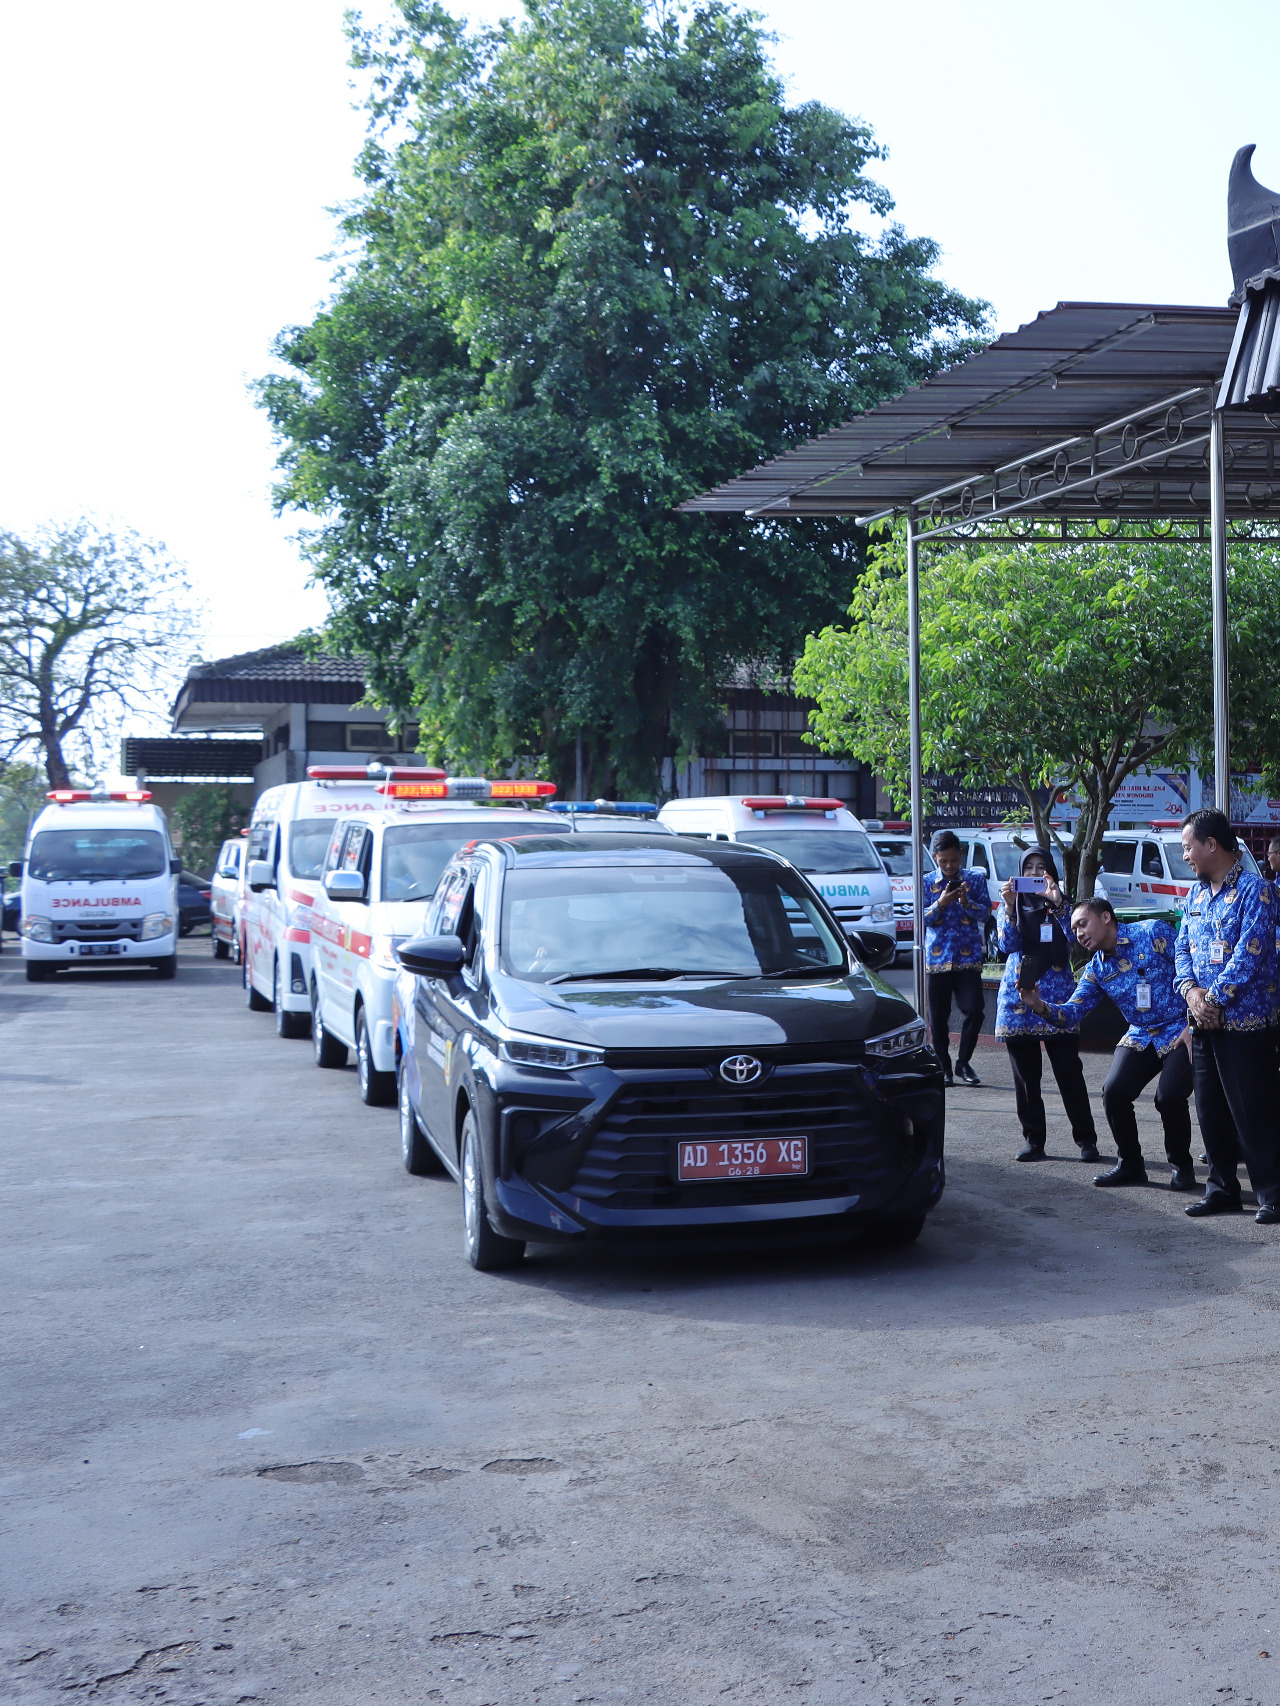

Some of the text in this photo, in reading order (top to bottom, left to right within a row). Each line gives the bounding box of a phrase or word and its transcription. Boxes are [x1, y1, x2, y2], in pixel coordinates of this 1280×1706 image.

[683, 1140, 802, 1167] AD 1356 XG
